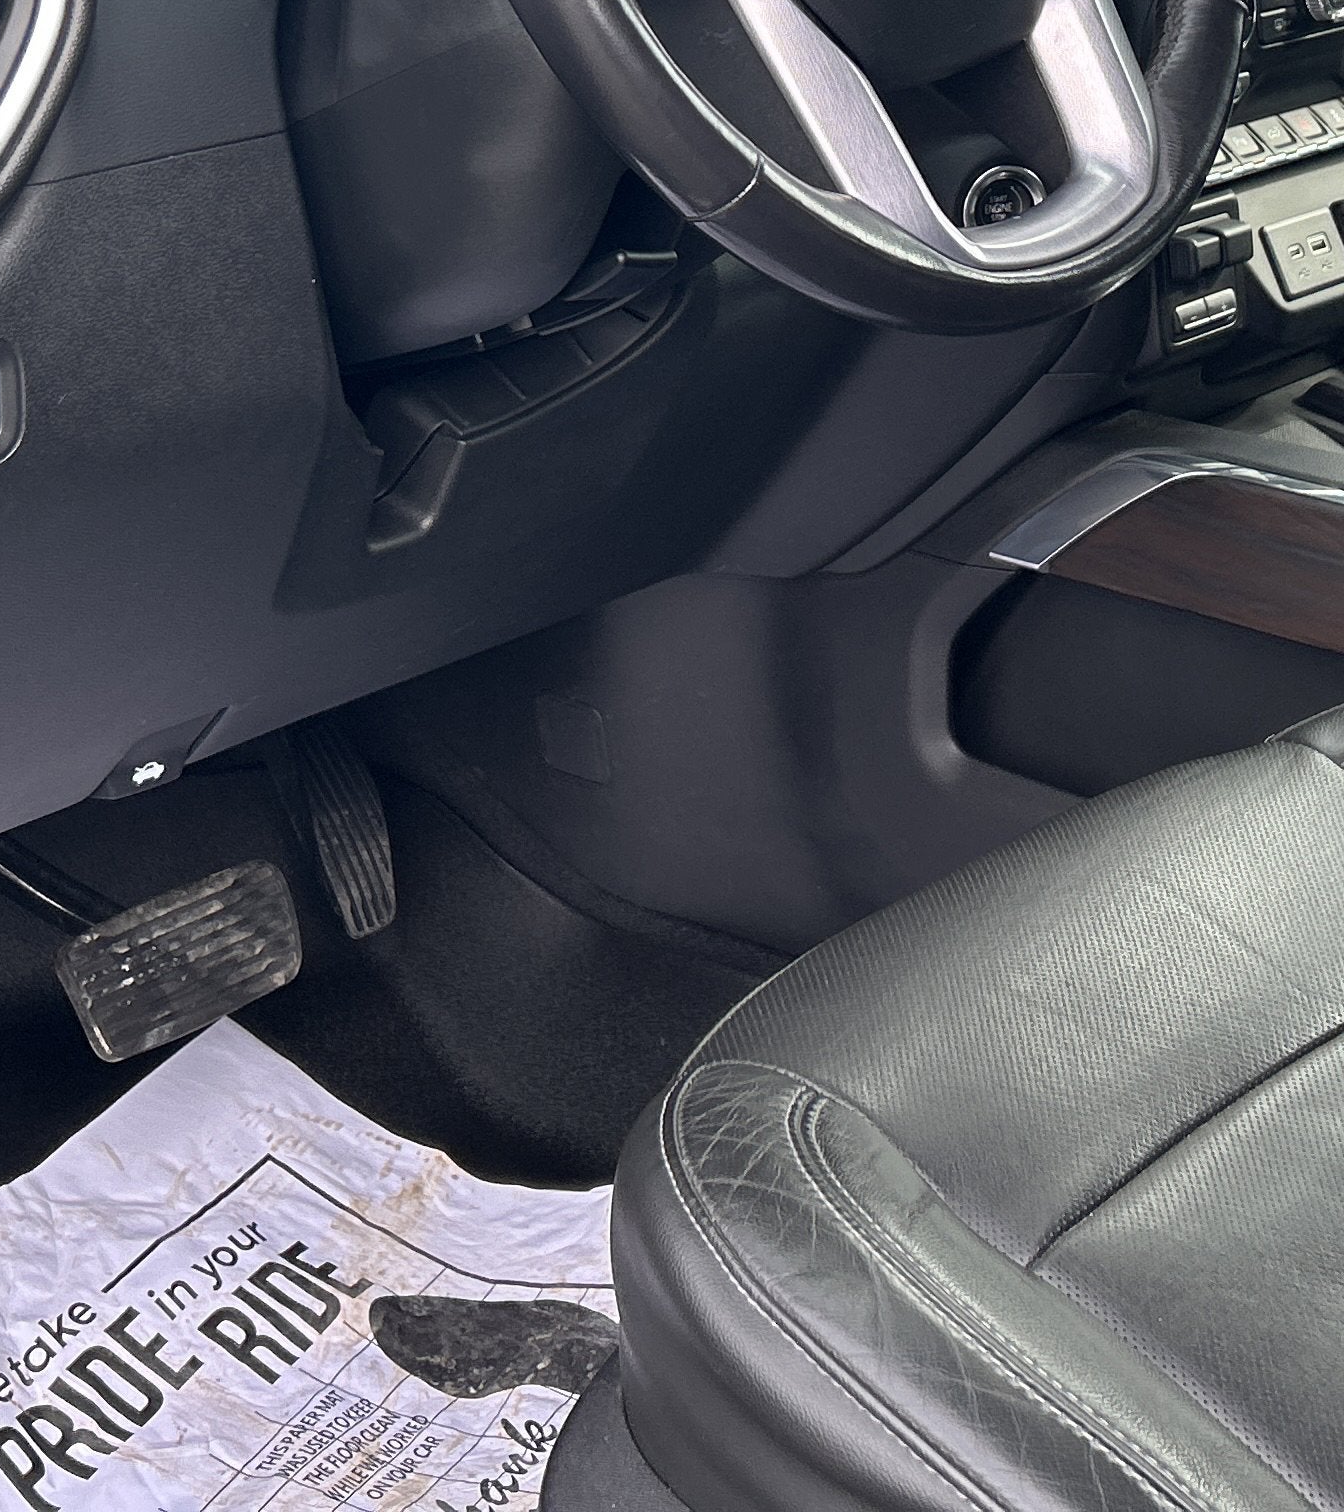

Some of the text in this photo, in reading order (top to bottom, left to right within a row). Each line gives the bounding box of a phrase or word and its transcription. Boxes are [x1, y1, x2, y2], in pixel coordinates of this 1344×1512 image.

[984, 202, 1013, 215] ENGINE
[146, 1221, 269, 1320] in your
[7, 1300, 97, 1387] take
[197, 1240, 374, 1385] RIDE
[255, 1389, 346, 1471] THIS PAPER MAT
[277, 1397, 375, 1478] WAS USED TO KEEP
[302, 1408, 401, 1486] THE FLOOR CLEAN
[324, 1414, 429, 1502] WHILE WE WORKED
[366, 1435, 445, 1500] ON YOUR CAR
